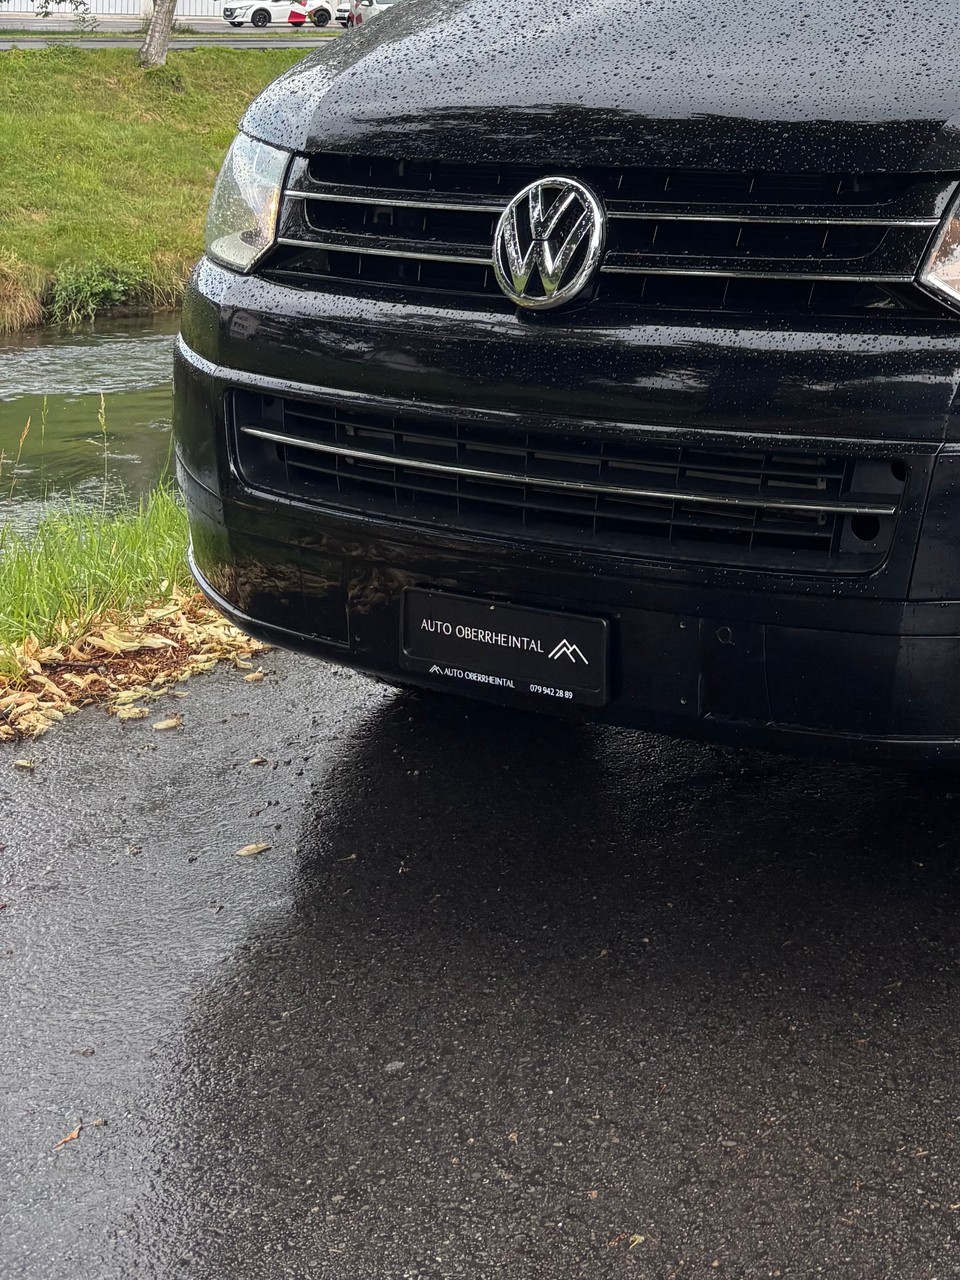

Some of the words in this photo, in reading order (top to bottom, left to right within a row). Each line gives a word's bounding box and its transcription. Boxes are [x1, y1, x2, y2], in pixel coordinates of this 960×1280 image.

[496, 179, 602, 305] VW
[421, 619, 452, 635] AUTO
[456, 625, 544, 653] OBERRHEINTAL
[444, 668, 463, 678] AUTO
[465, 672, 515, 688] OBERRHEINTAL
[530, 684, 541, 693] 079
[542, 687, 554, 696] 942
[555, 689, 564, 697] 28
[564, 691, 573, 699] 89
